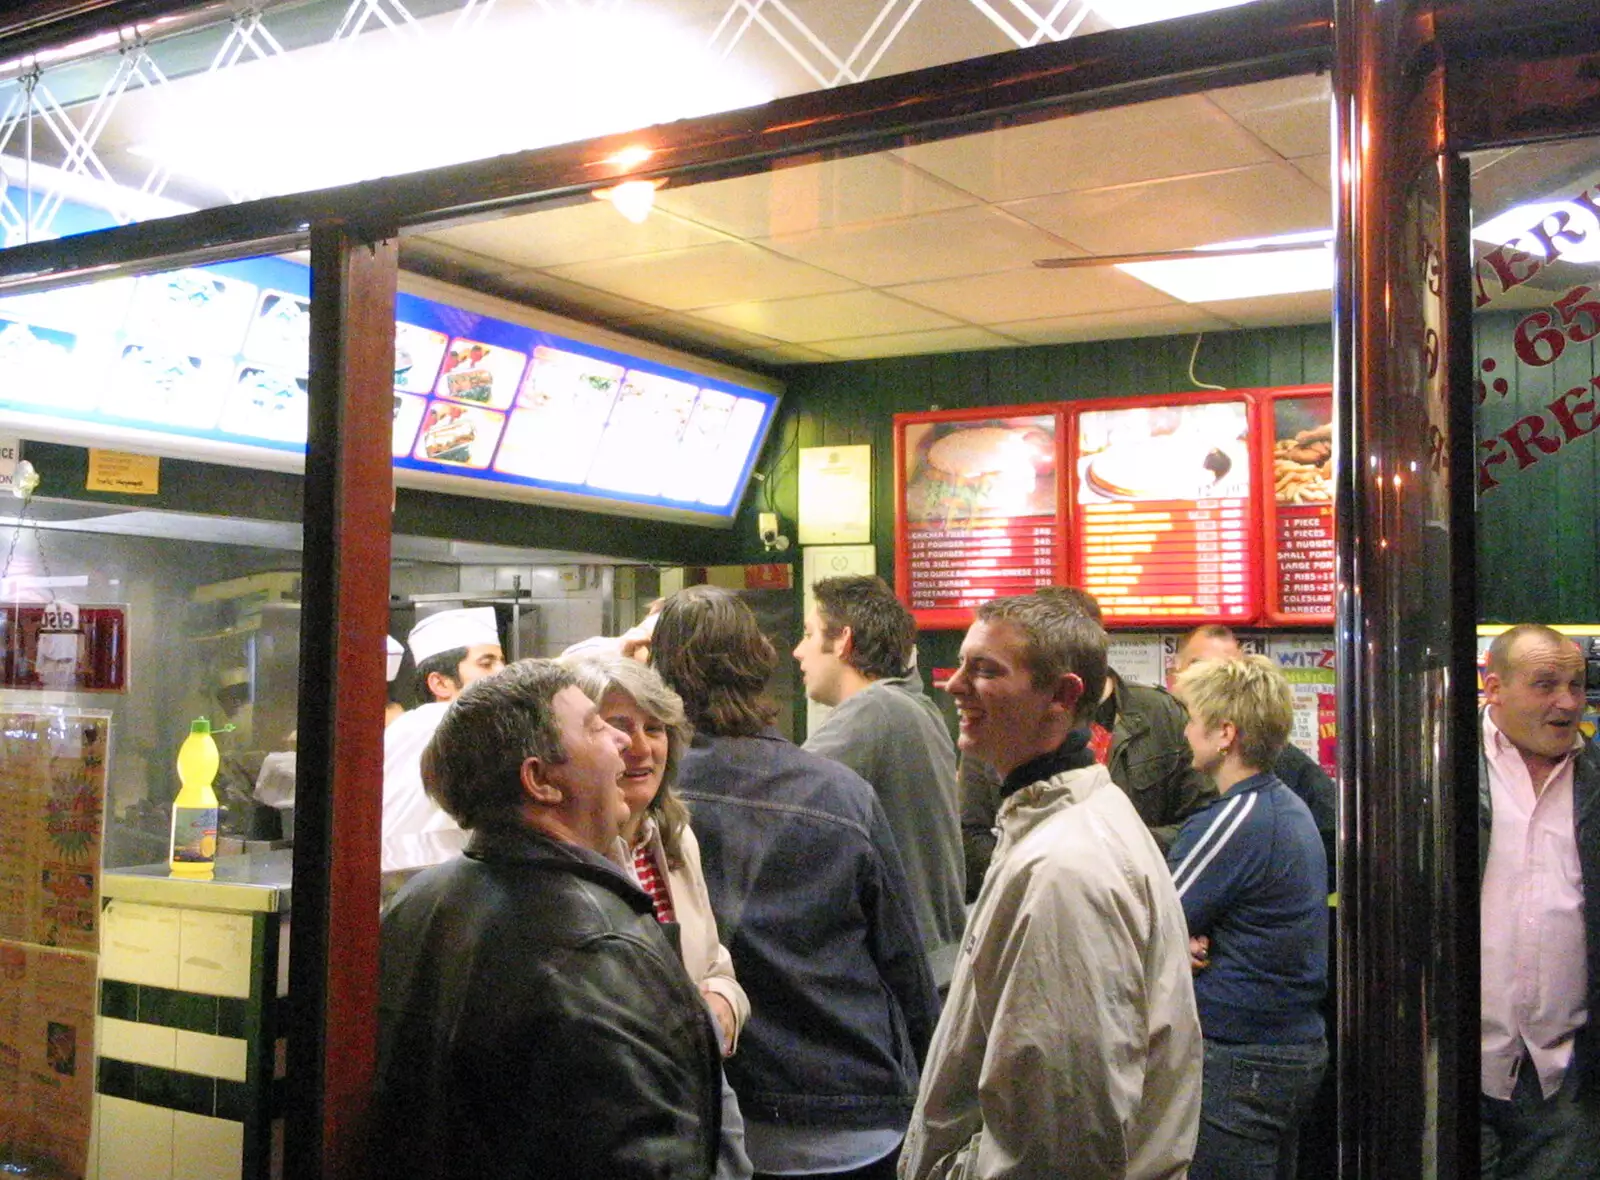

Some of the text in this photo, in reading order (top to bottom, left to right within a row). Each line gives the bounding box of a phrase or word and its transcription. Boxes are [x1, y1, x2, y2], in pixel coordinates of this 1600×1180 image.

[1293, 518, 1320, 527] PIECE
[1293, 529, 1326, 537] PIECES
[1277, 551, 1306, 560] SMALL
[1280, 562, 1310, 571] LARGE
[1283, 573, 1290, 581] 2
[1283, 584, 1290, 592] 2
[1283, 594, 1332, 603] COLESLAW
[1284, 605, 1332, 613] BARBECUE
